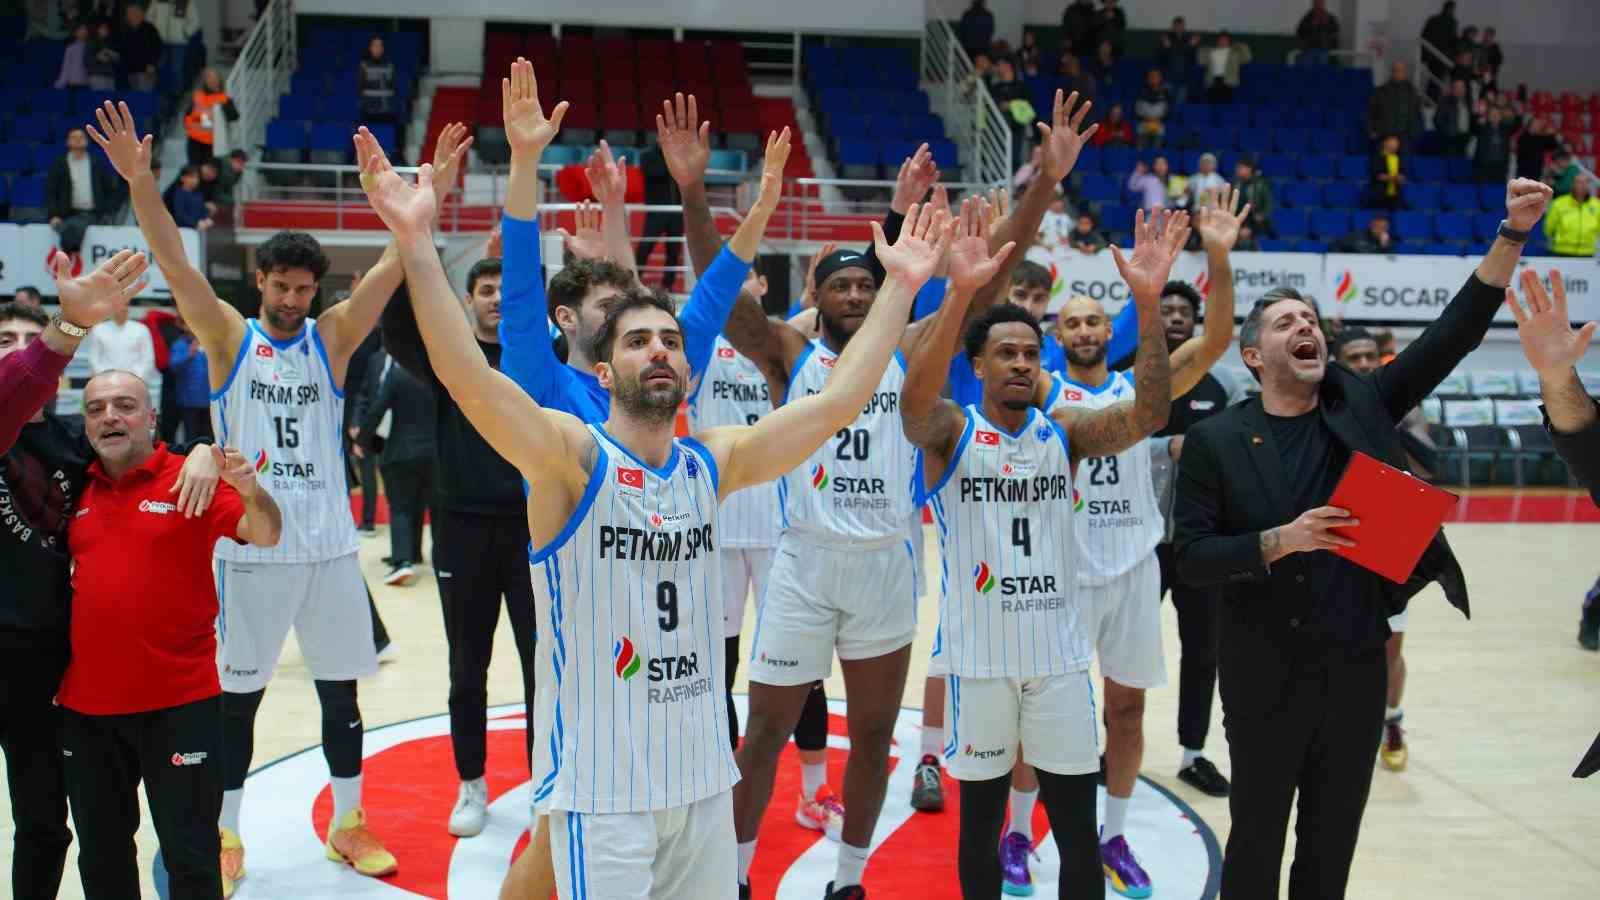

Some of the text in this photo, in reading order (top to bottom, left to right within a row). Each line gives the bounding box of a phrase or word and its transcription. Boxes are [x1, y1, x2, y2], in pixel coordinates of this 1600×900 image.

[1233, 268, 1306, 288] Petkim
[1071, 280, 1131, 301] SOC
[1363, 286, 1450, 306] SOCAR
[274, 416, 299, 448] 15
[836, 427, 869, 461] 20
[273, 462, 315, 478] STAR
[1088, 455, 1119, 485] 23
[833, 477, 884, 493] STAR
[1033, 474, 1067, 502] SPOR
[1089, 499, 1131, 514] STAR
[1011, 518, 1031, 556] 4
[1001, 575, 1056, 595] STAR
[656, 581, 679, 632] 9
[648, 652, 699, 681] STAR
